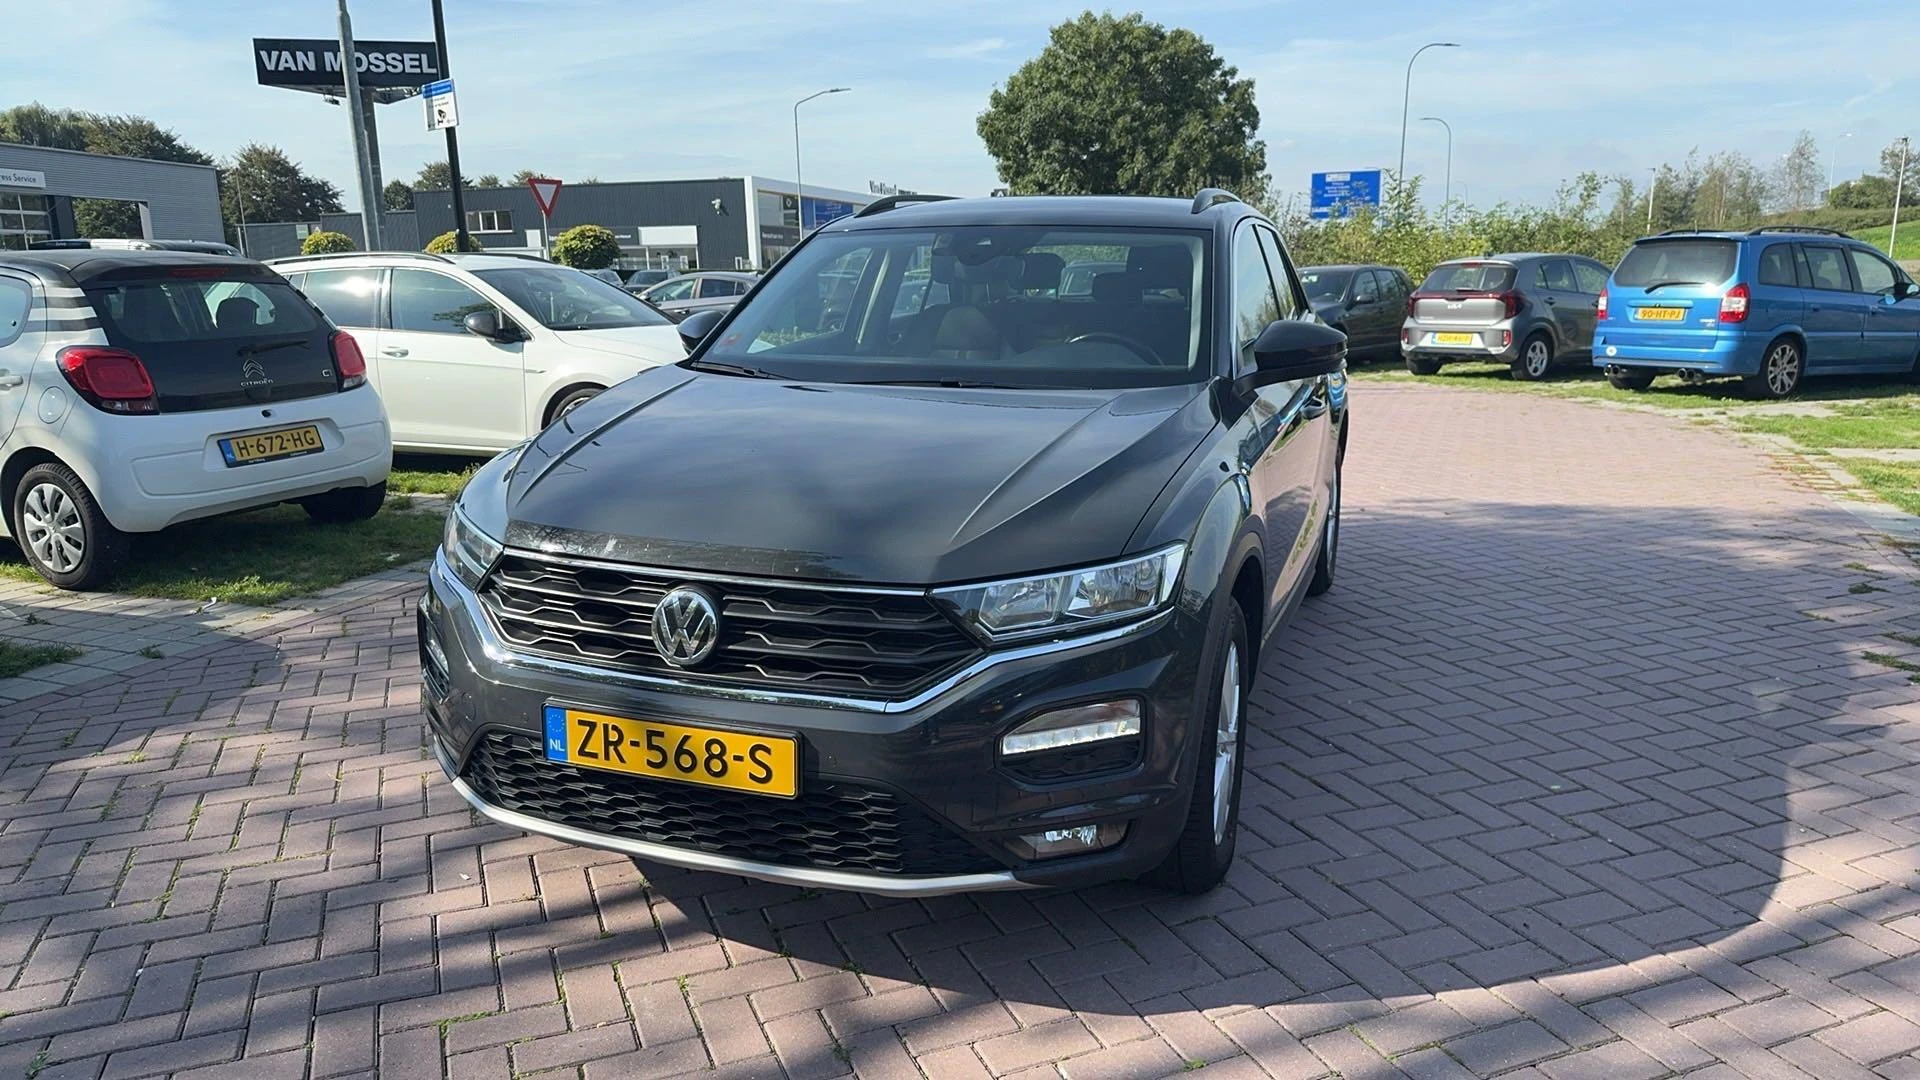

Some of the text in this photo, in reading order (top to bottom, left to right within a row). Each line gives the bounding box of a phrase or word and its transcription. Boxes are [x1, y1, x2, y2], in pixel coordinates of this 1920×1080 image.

[259, 50, 317, 72] VAN
[13, 173, 36, 183] Service
[1641, 308, 1681, 320] 90-HT-PJ
[236, 430, 316, 458] H-672-HG
[549, 718, 773, 785] NL ZR-568-S
